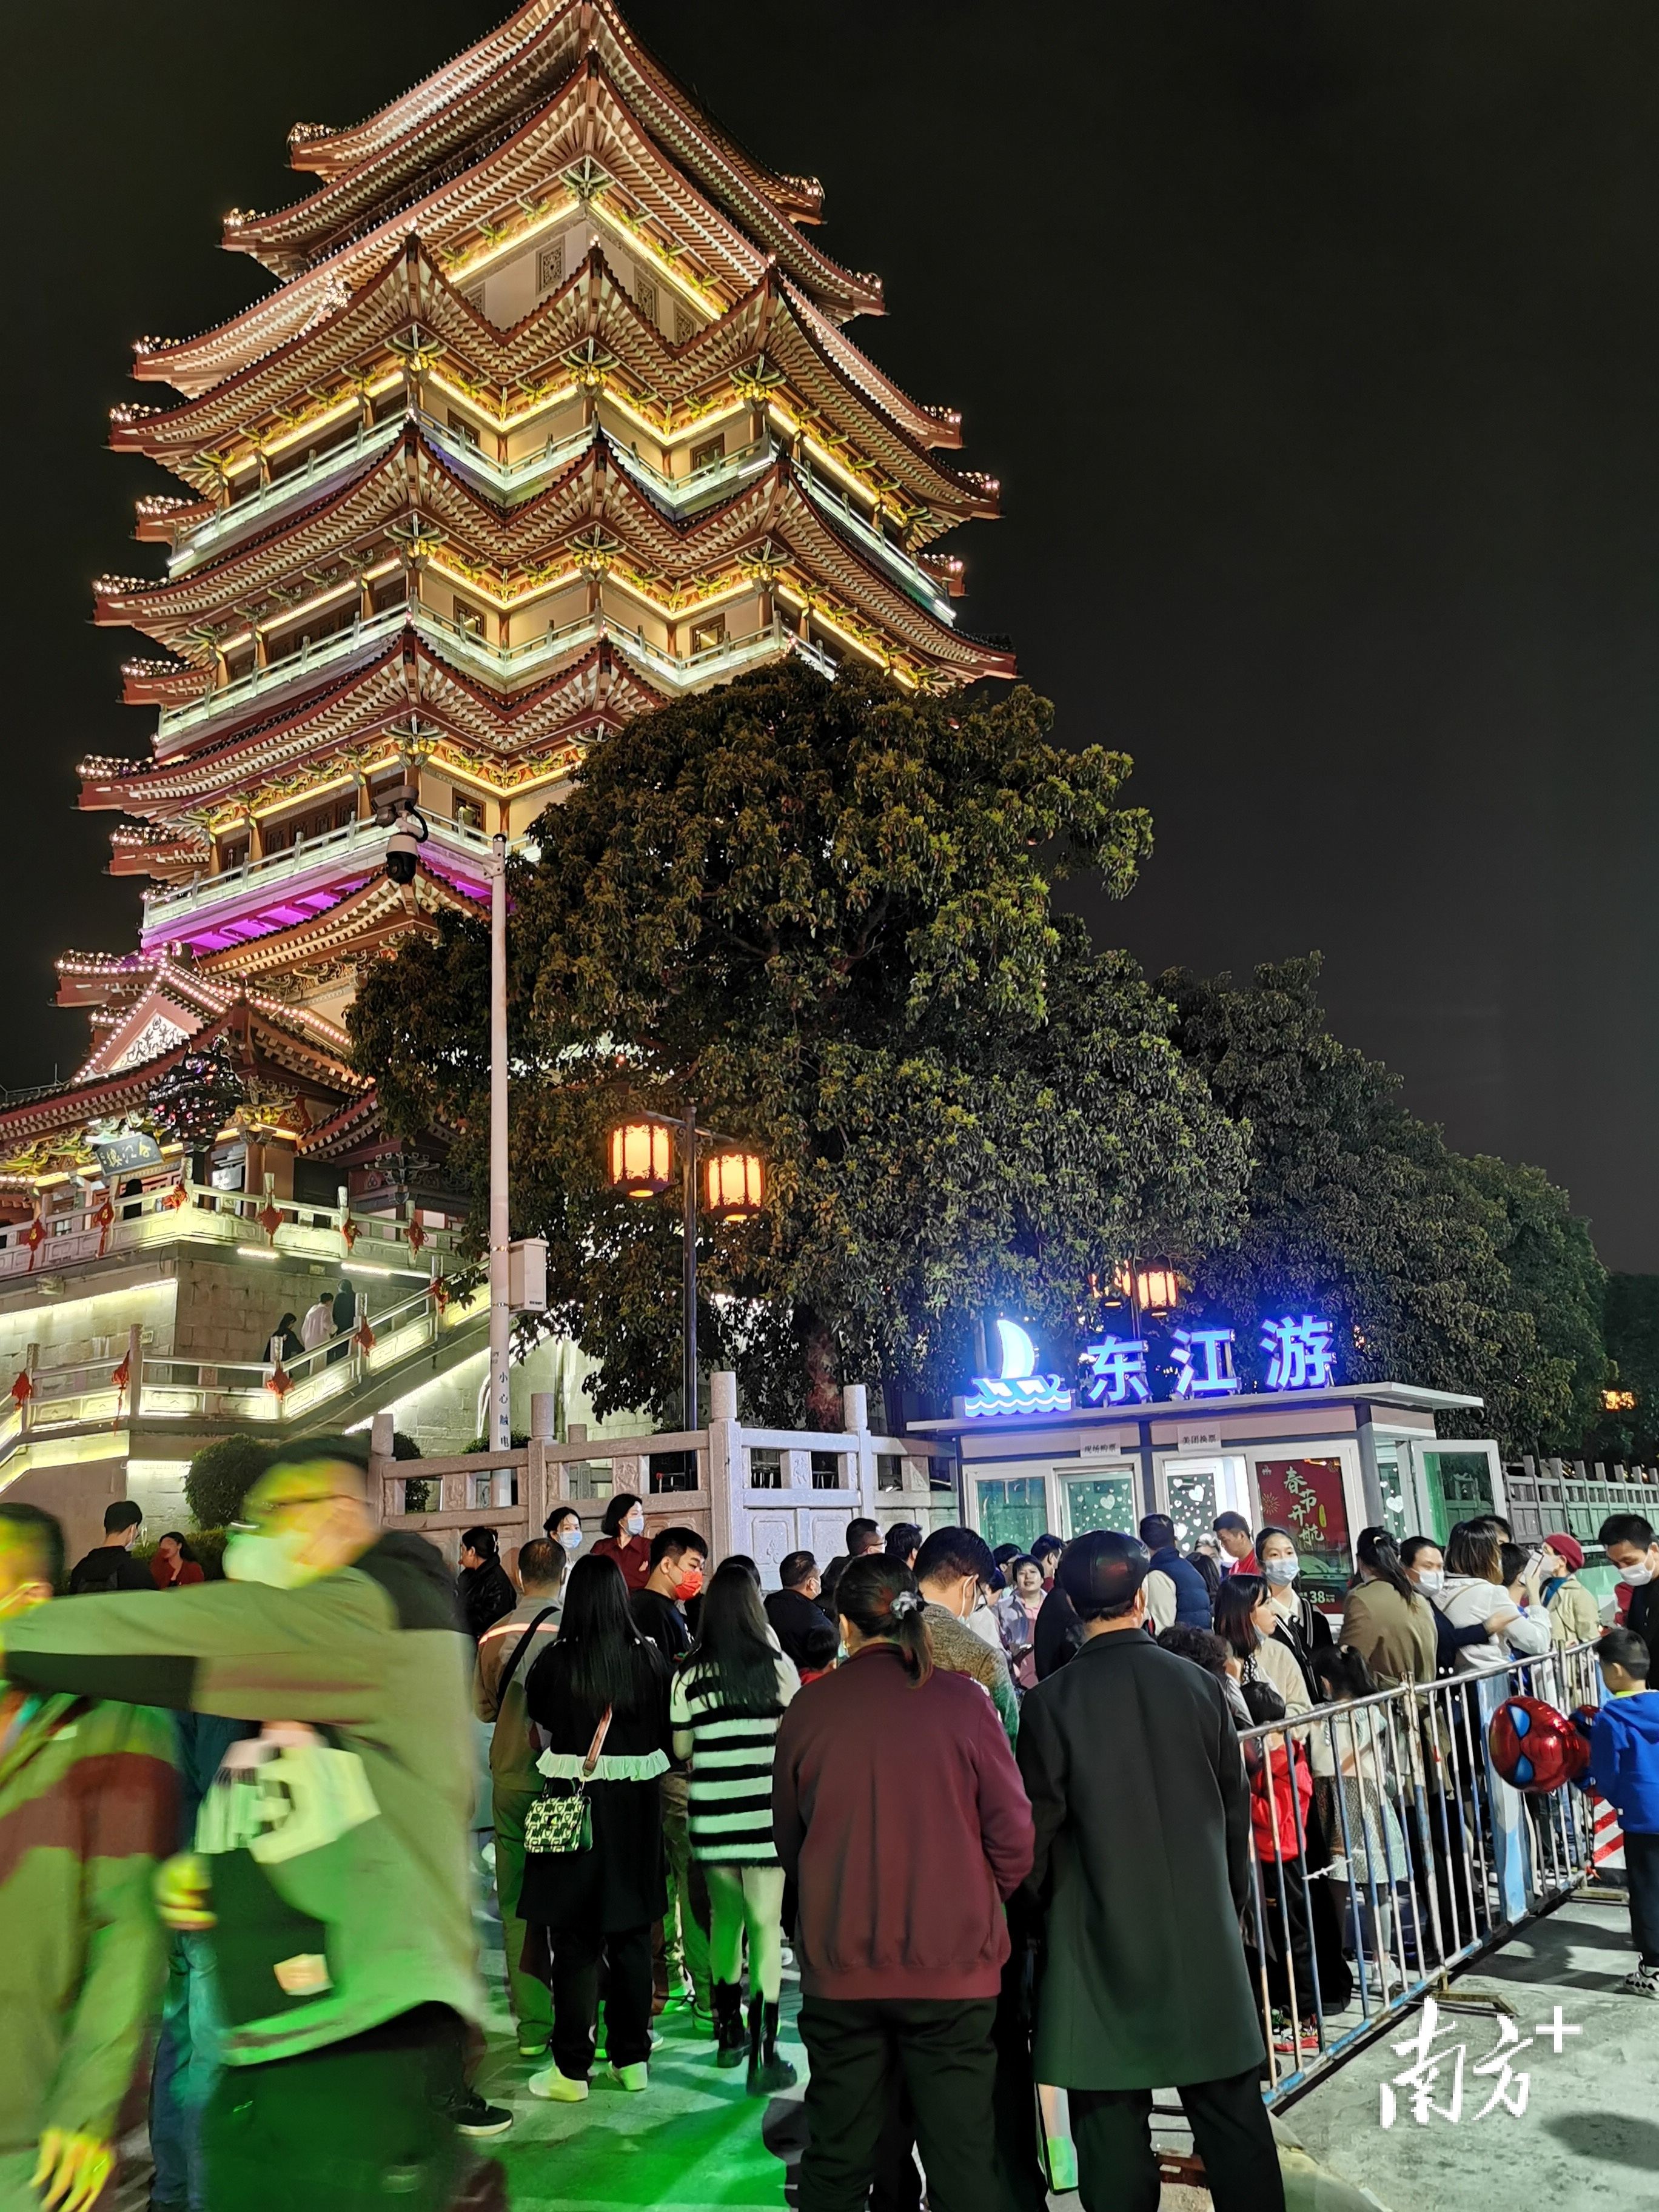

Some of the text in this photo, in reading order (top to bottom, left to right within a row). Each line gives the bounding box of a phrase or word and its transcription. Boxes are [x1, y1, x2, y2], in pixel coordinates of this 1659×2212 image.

[1087, 1315, 1334, 1401] 东江游
[1183, 1434, 1216, 1445] 美团换票
[1084, 1443, 1117, 1453] 现场购票
[1284, 1466, 1324, 1546] 春节开航
[1310, 1590, 1326, 1604] 38
